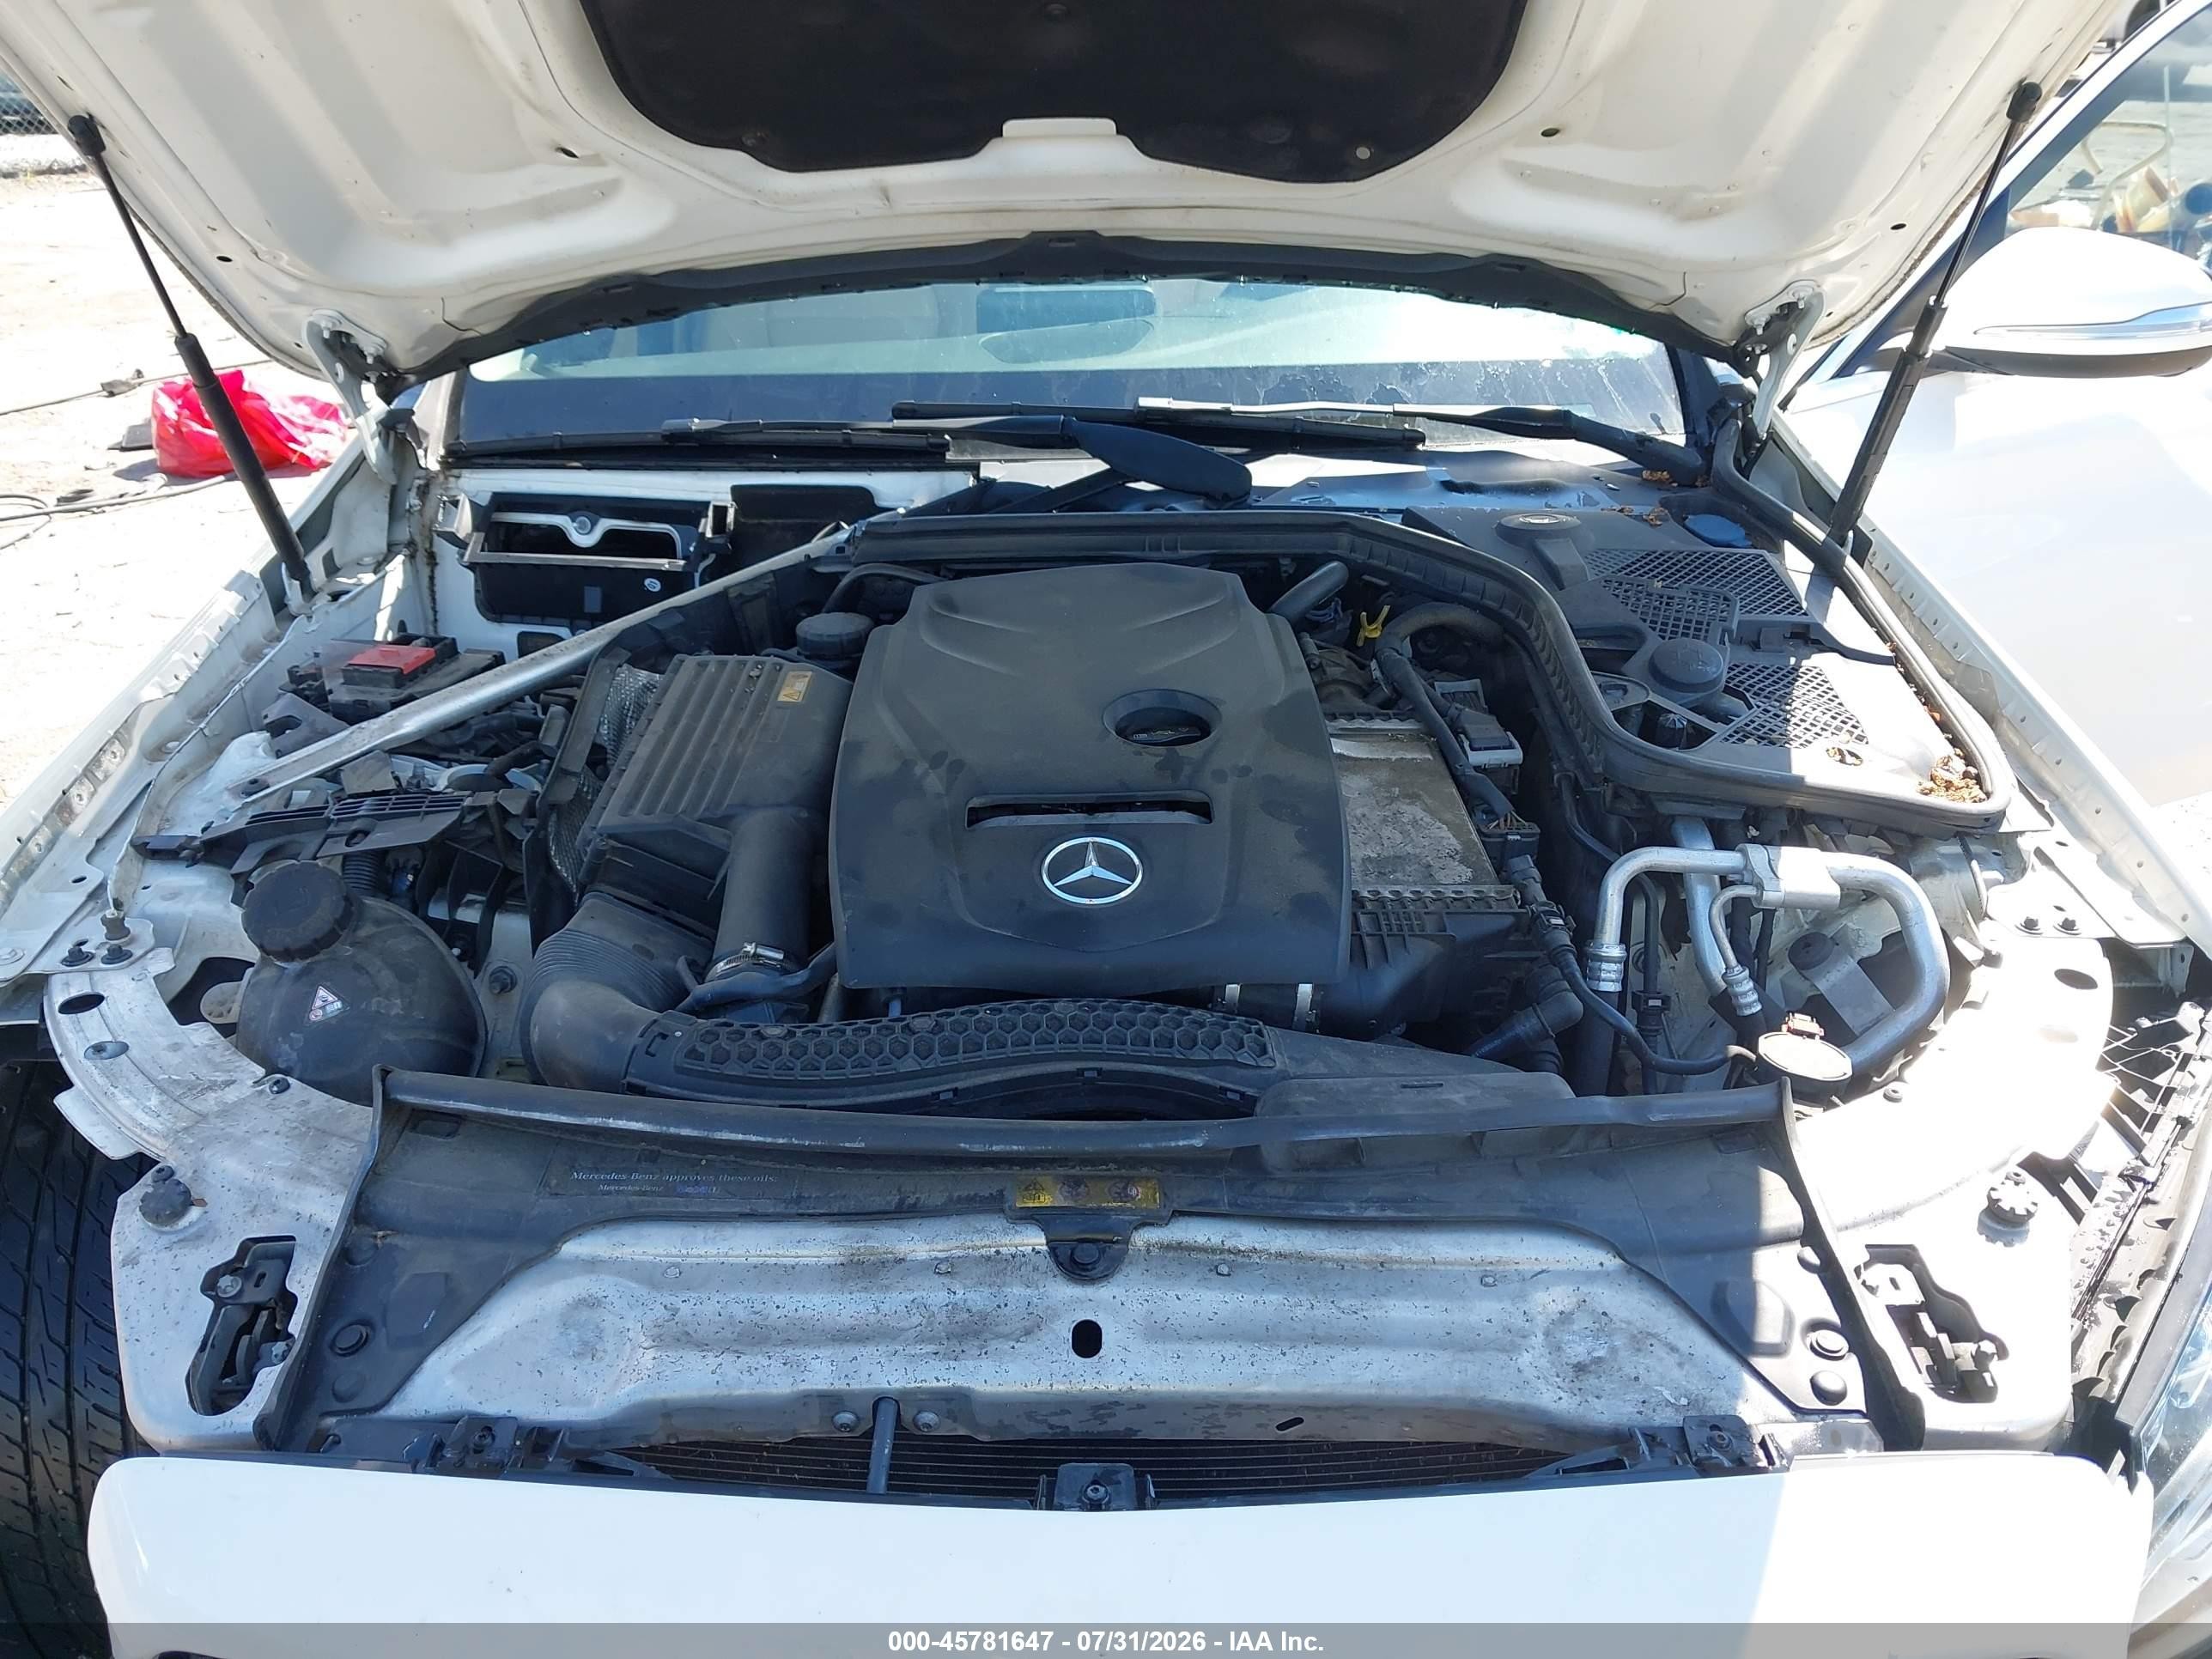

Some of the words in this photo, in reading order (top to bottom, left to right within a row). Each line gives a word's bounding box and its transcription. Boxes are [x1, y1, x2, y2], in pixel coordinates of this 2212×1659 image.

[571, 1171, 660, 1181] Mercedes-Benz
[662, 1174, 716, 1182] approves
[718, 1174, 750, 1182] these
